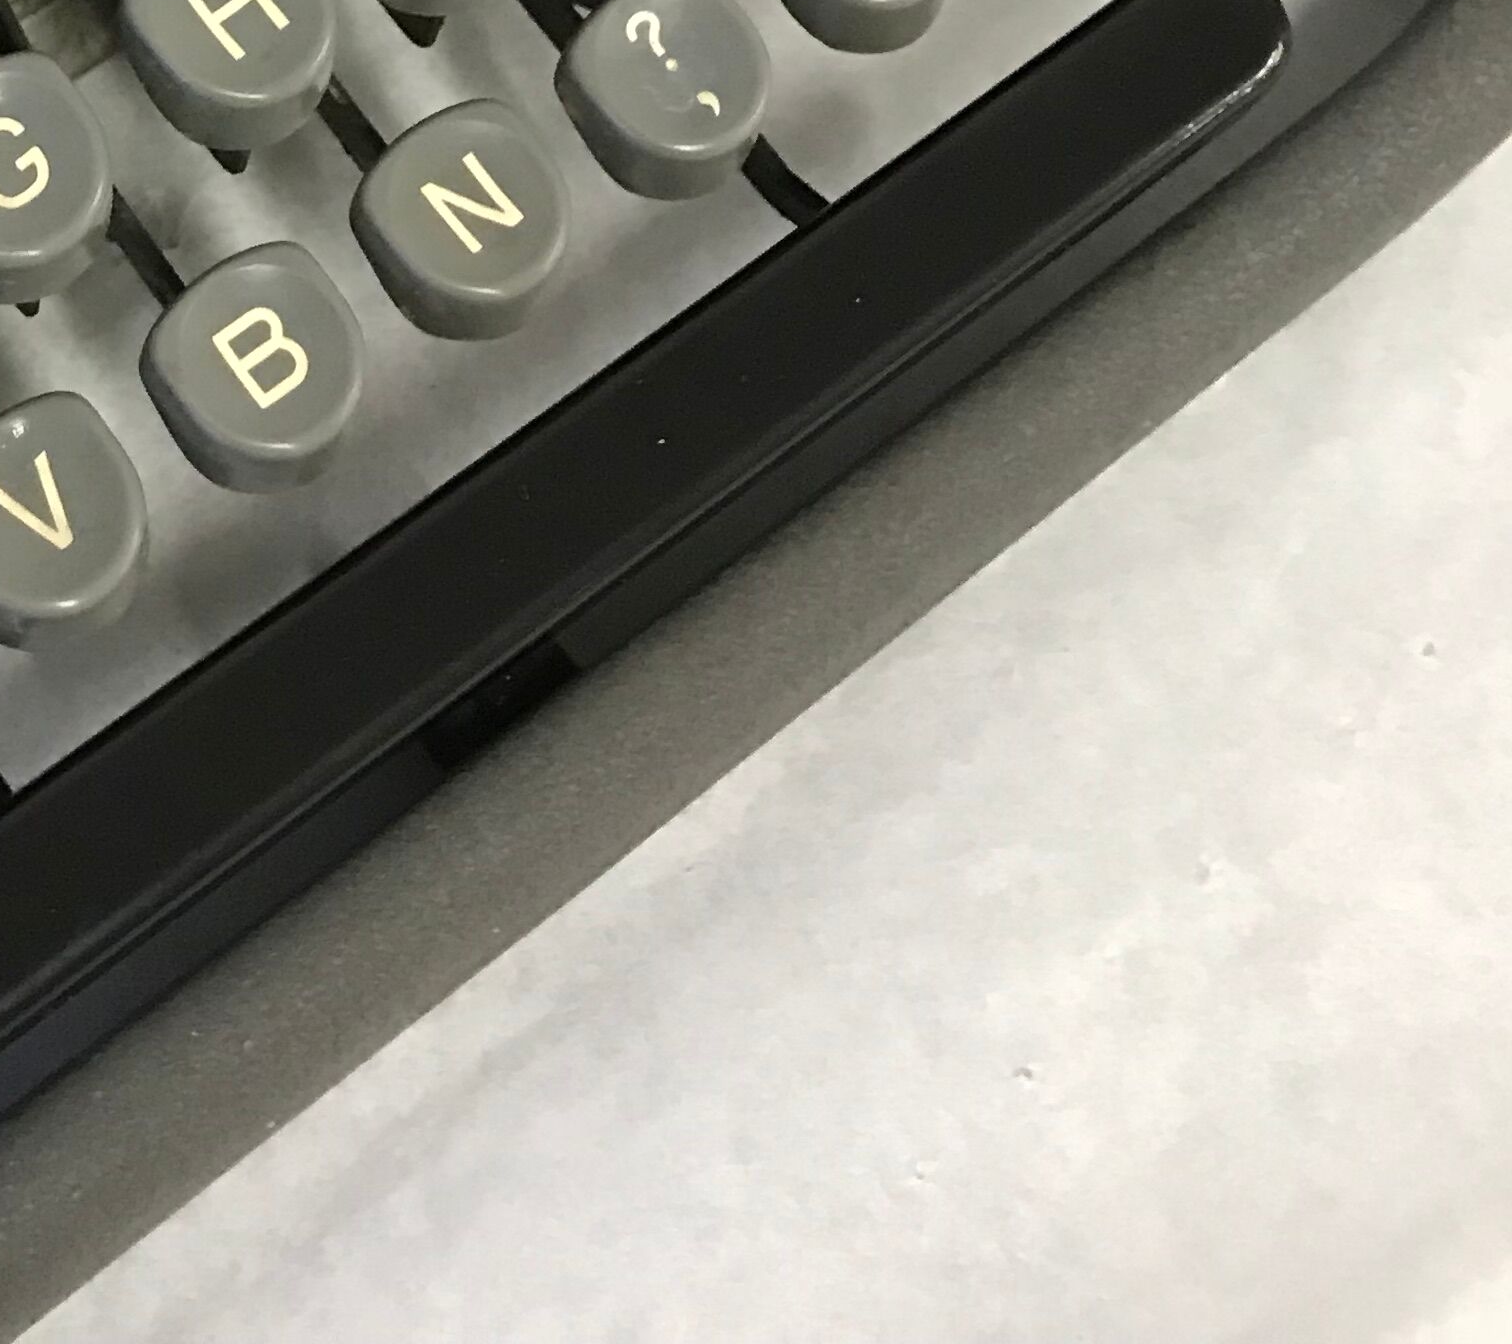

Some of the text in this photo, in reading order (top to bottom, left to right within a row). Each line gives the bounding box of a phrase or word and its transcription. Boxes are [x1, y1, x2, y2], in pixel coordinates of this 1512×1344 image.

[625, 10, 678, 71] ?
[420, 151, 525, 254] N
[212, 307, 309, 409] B
